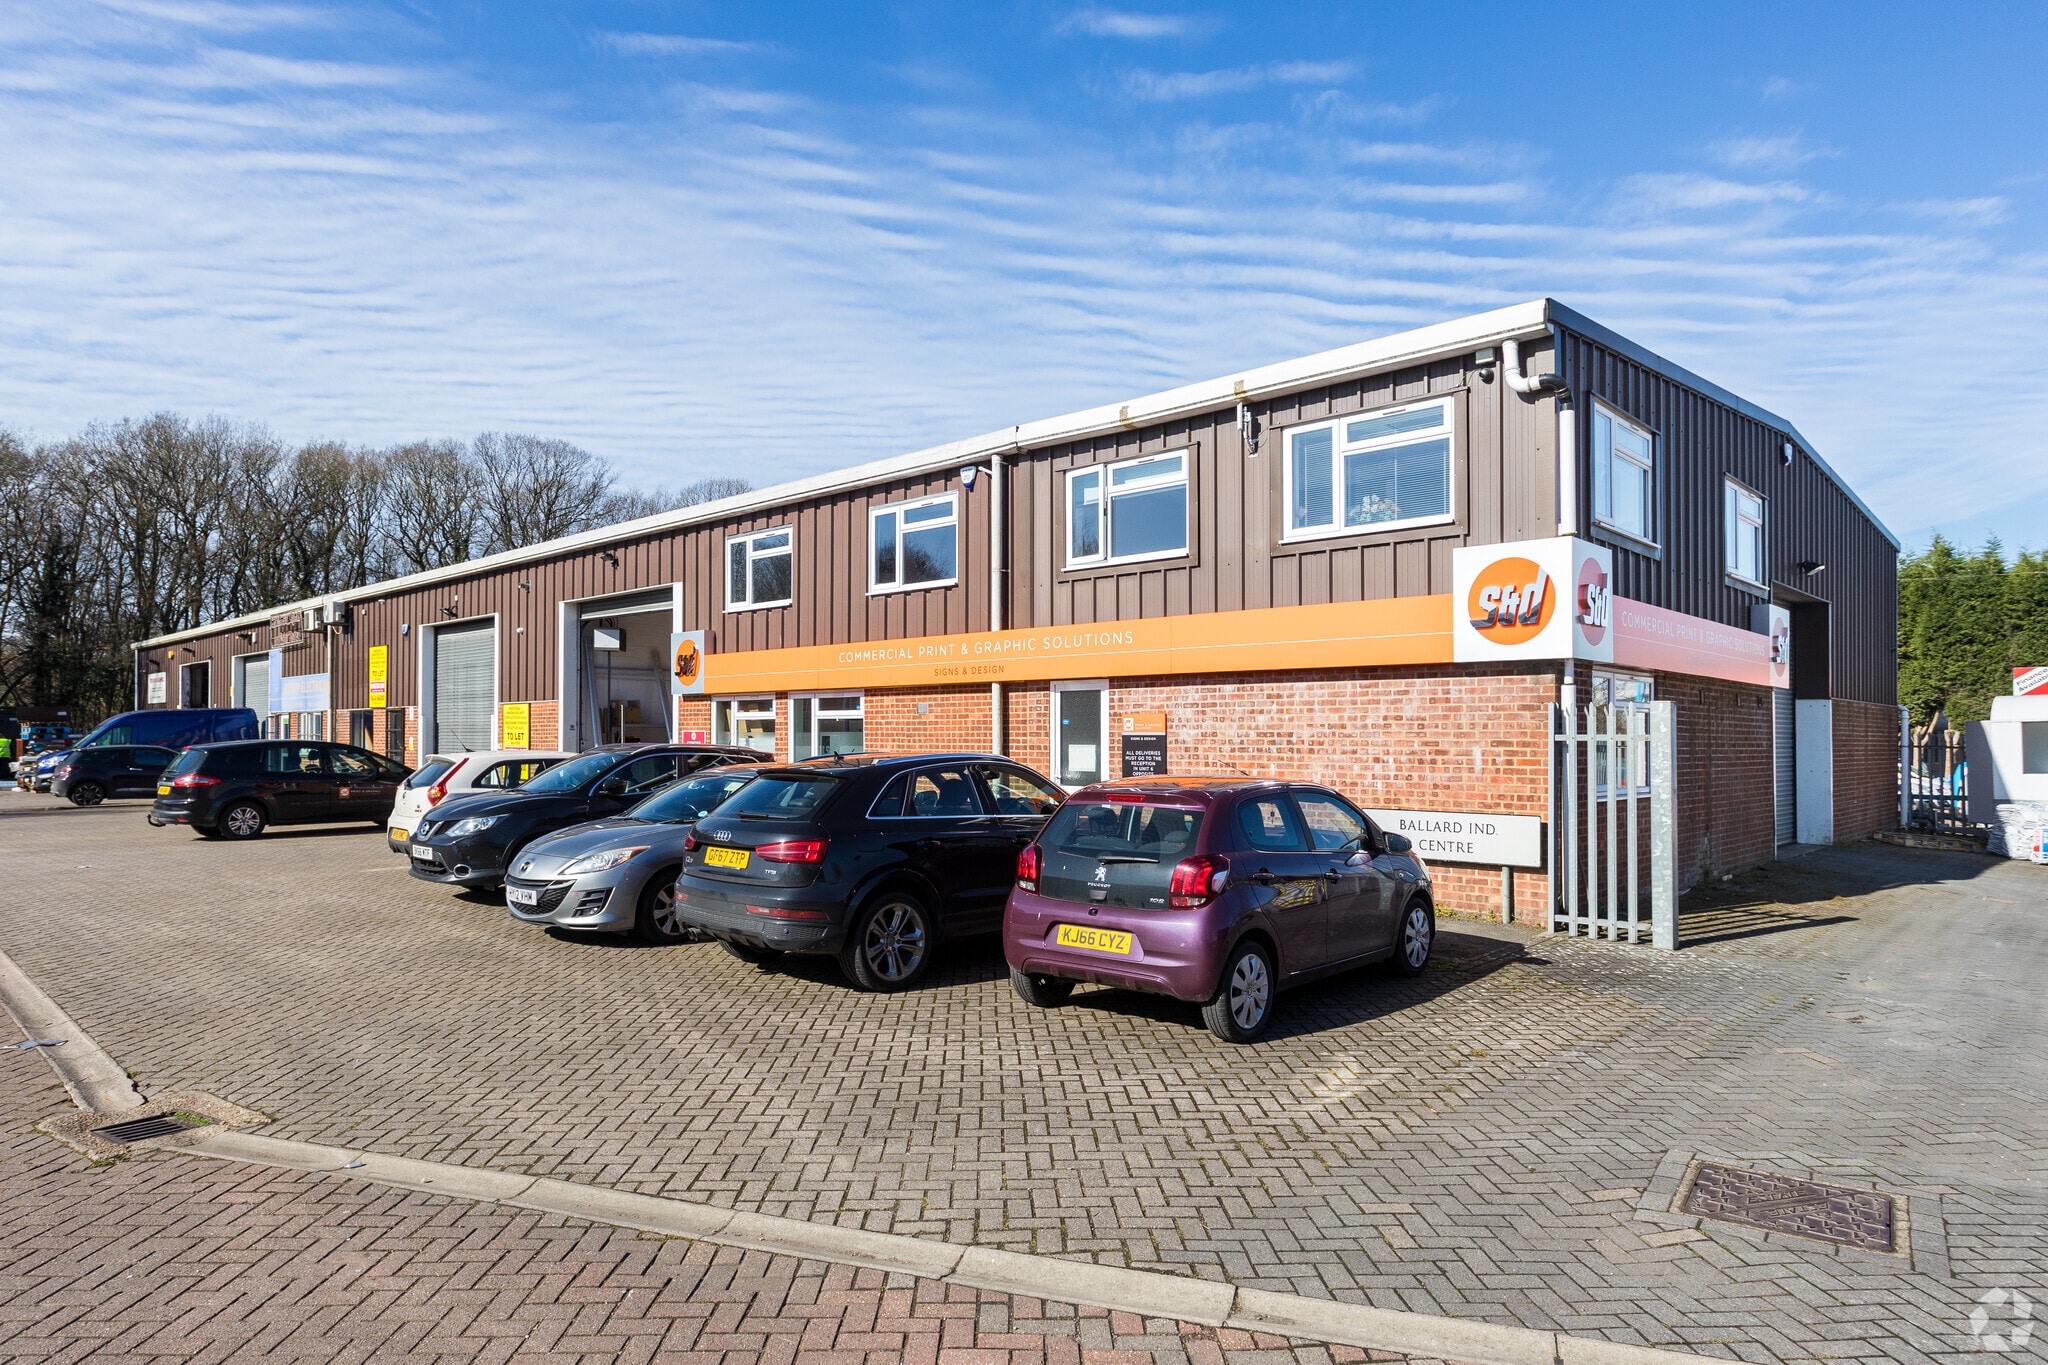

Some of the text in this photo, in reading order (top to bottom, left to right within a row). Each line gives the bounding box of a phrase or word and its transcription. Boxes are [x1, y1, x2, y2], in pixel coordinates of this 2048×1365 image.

[1621, 611, 1765, 656] COMMERCIAL PRINT & GRAPHIC SOLUTIONS
[838, 630, 1134, 663] COMMERCIAL PRINT & GRAPHIC SOLUTIONS
[934, 665, 1004, 677] SIGNS & DESIGN
[2016, 668, 2048, 686] Finance
[507, 732, 525, 741] TO LET
[1399, 819, 1499, 836] BALLARD IND.
[1418, 839, 1474, 854] CENTRE
[708, 848, 746, 865] GF67 ZTP
[1062, 927, 1126, 950] KJ66 CYZ
